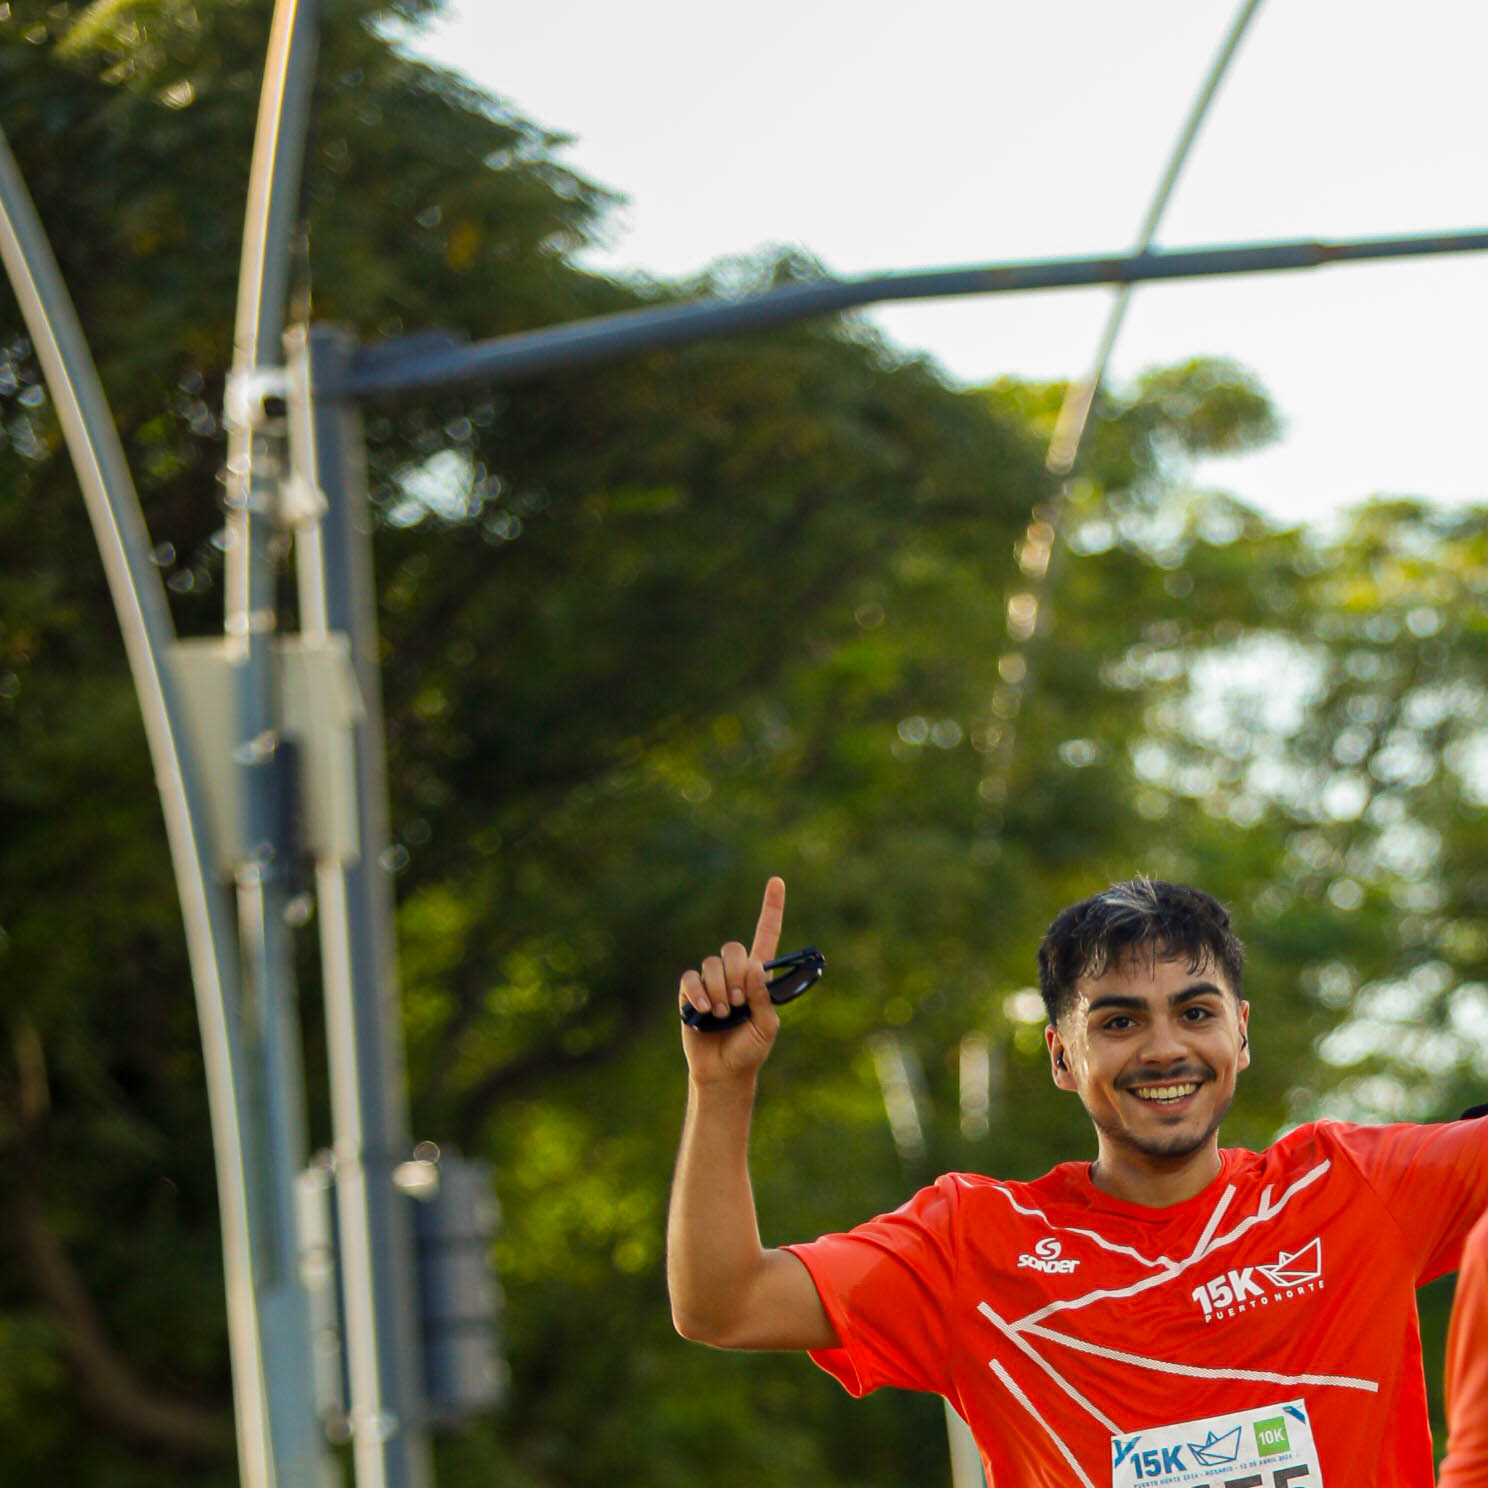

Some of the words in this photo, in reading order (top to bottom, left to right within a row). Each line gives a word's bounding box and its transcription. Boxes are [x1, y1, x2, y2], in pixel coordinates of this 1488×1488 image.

[1191, 1267, 1265, 1316] 15K
[1205, 1296, 1268, 1324] PUERTO
[1274, 1279, 1326, 1303] NORTE
[1258, 1427, 1286, 1446] 10K
[1130, 1444, 1187, 1479] 15K
